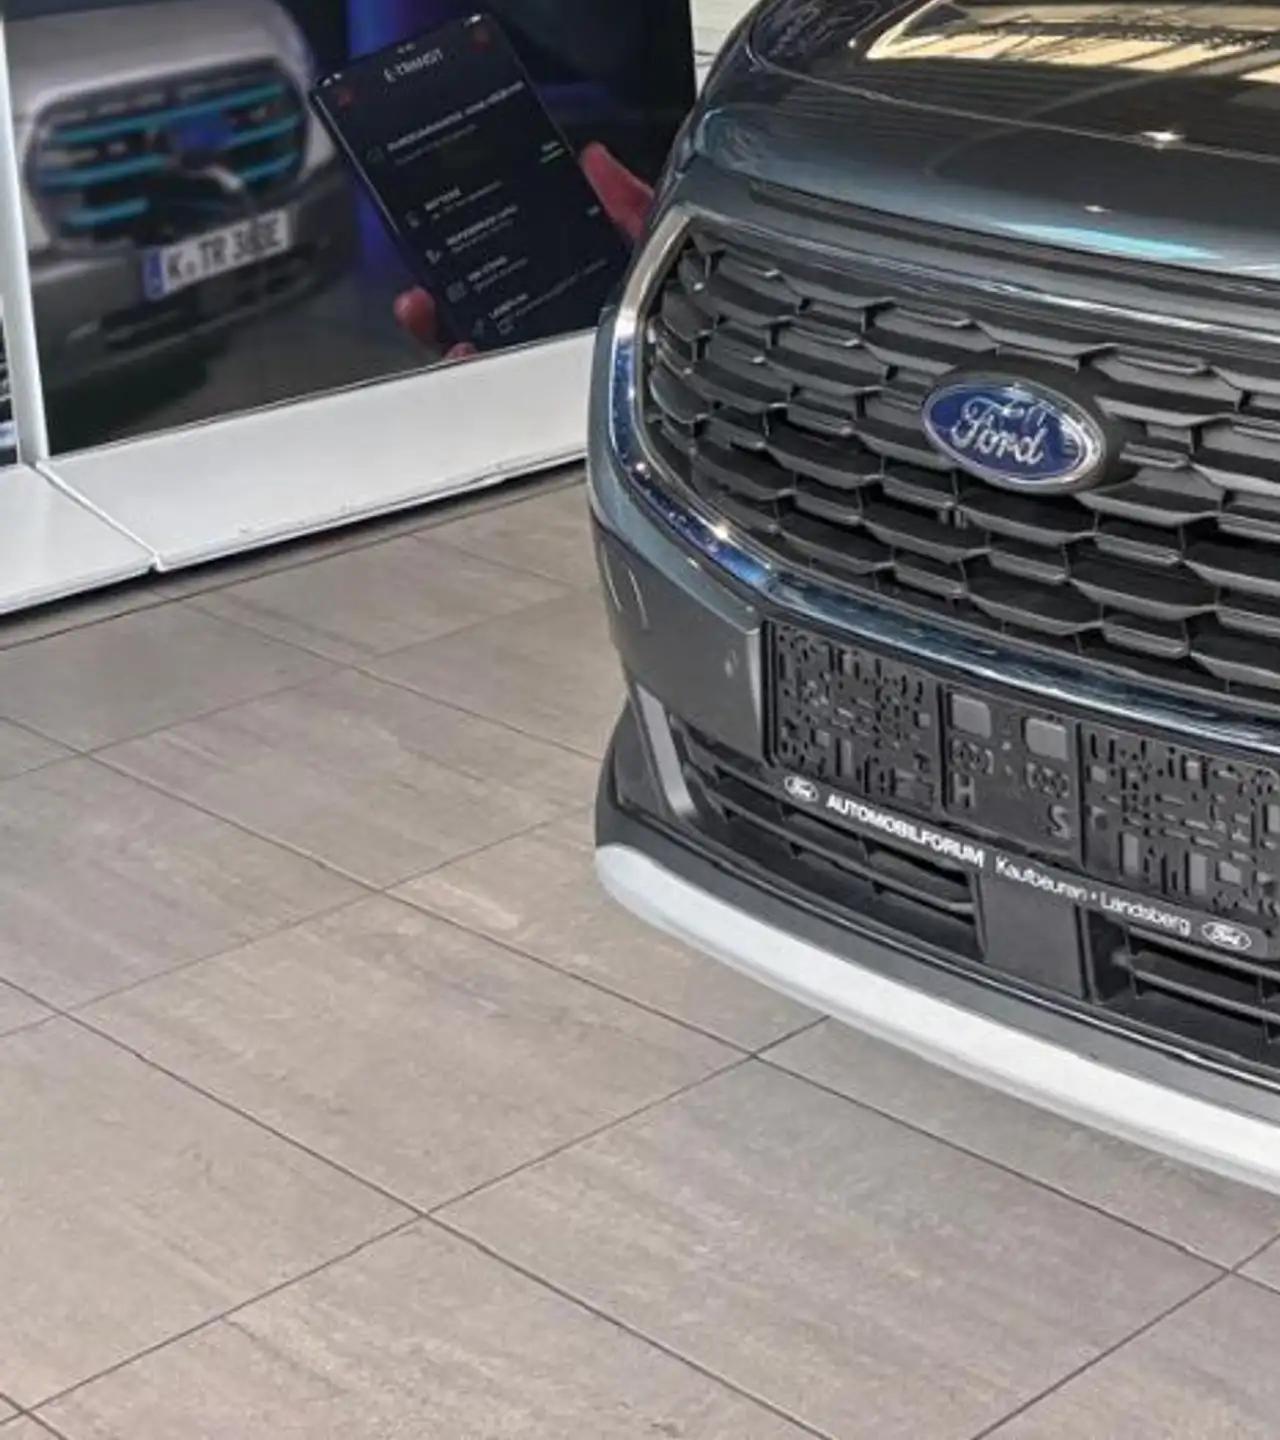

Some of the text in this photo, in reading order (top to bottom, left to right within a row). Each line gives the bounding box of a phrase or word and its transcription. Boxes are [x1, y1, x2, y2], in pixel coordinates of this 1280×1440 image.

[199, 234, 228, 273] TR
[950, 396, 1049, 465] Ford
[826, 793, 984, 869] AUTOMOBILFORUM
[1100, 891, 1192, 937] Landsberg
